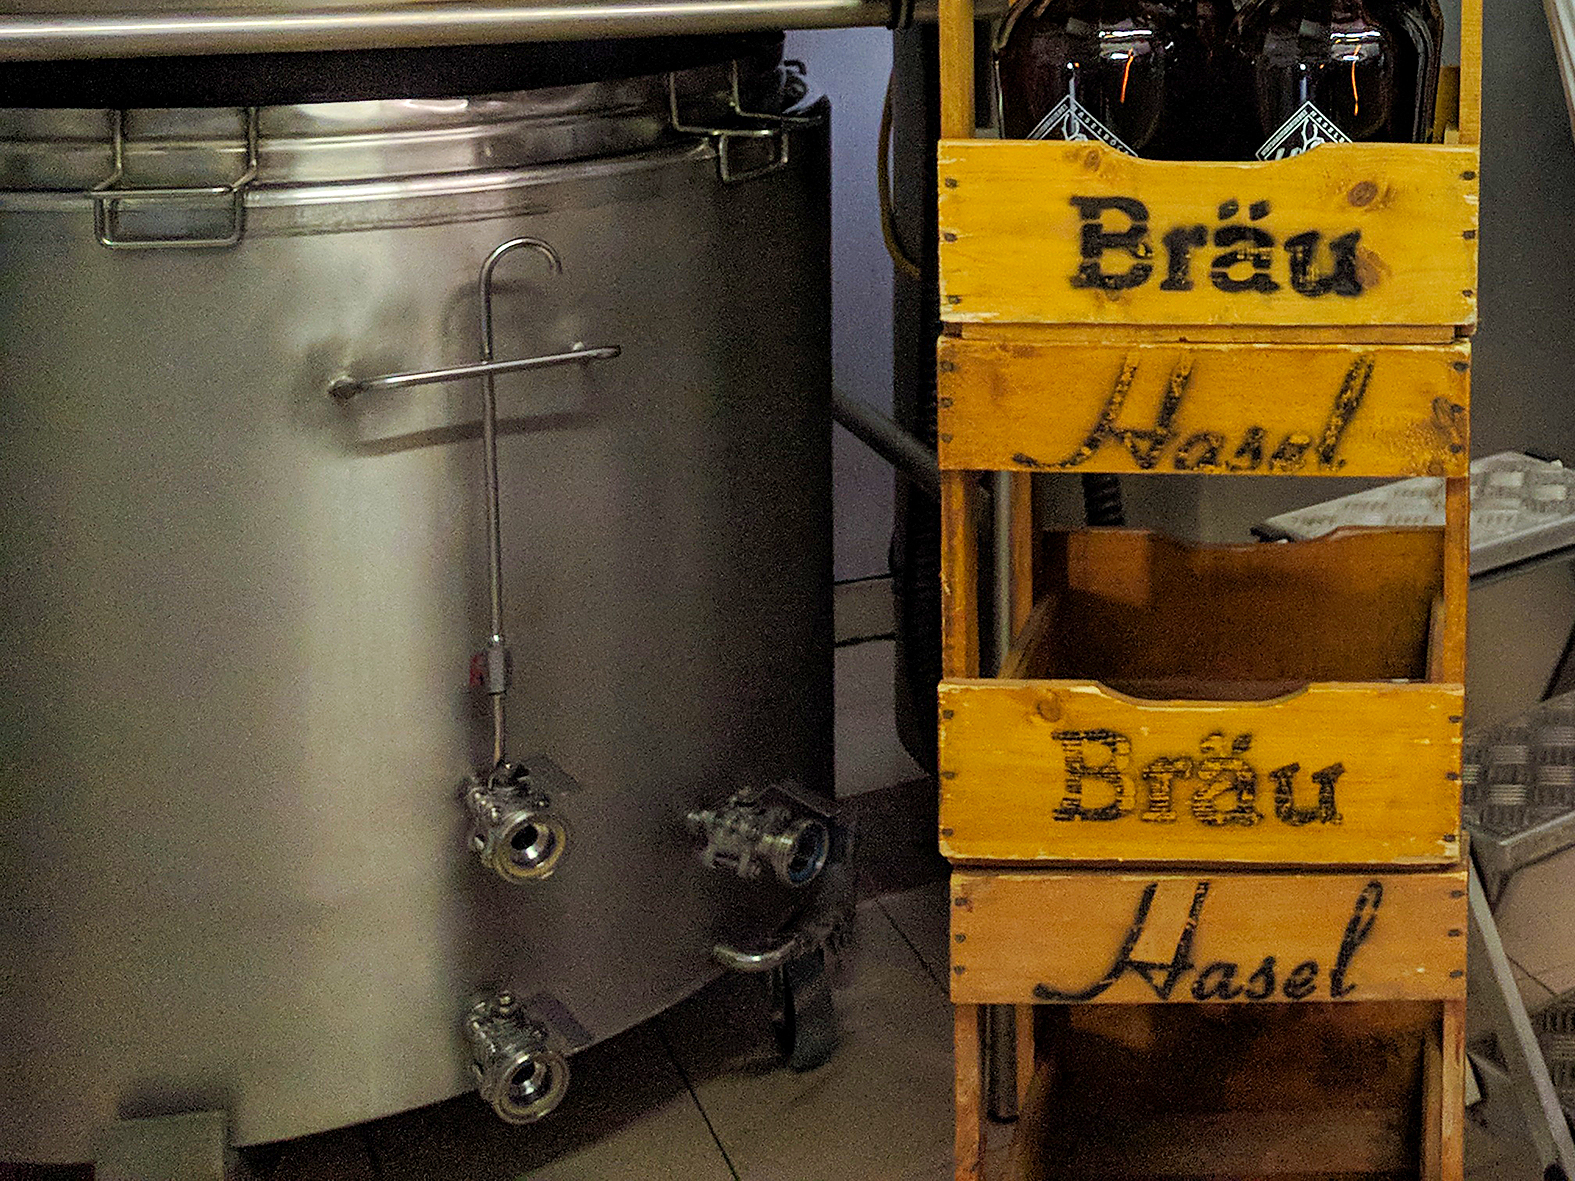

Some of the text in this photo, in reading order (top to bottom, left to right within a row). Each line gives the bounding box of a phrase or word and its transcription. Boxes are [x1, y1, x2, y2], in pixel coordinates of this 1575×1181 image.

[1068, 195, 1366, 298] Bräu
[1013, 350, 1376, 473] Hasel
[1050, 728, 1346, 828] Bräu
[1033, 880, 1384, 1003] Hasel
